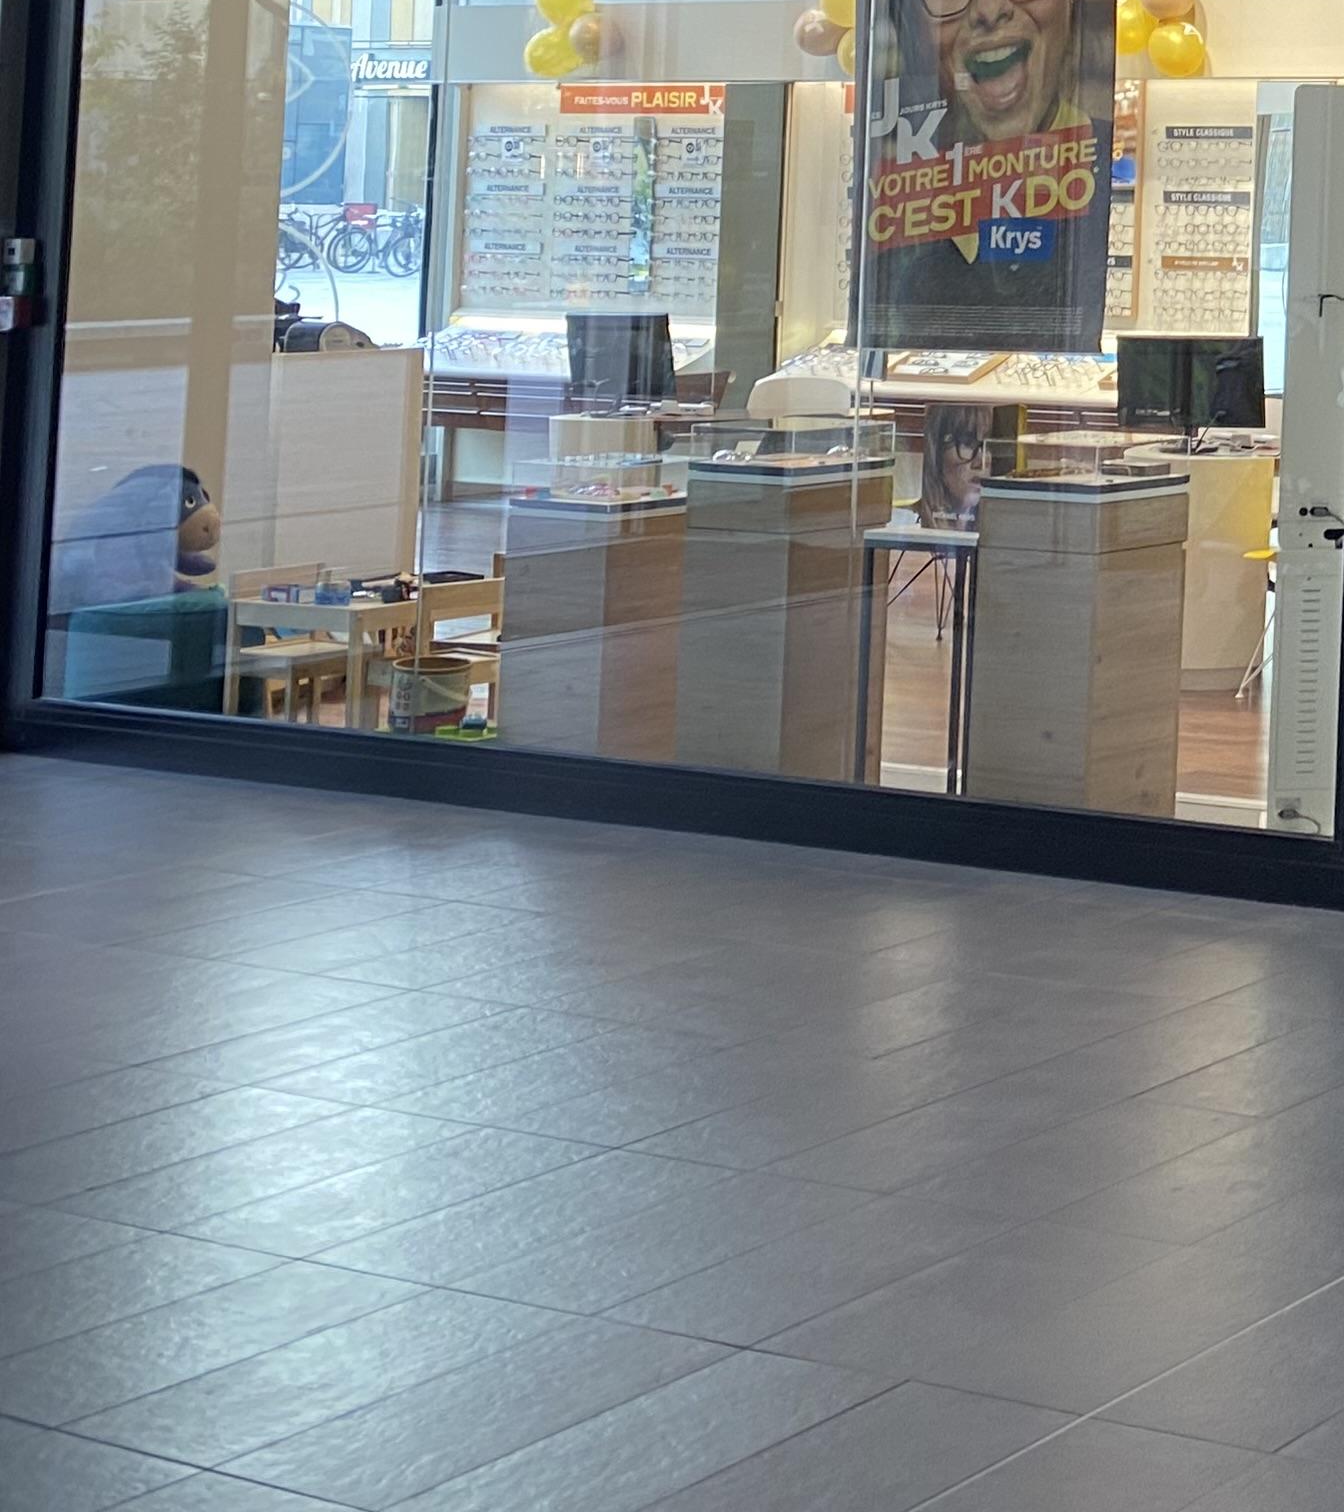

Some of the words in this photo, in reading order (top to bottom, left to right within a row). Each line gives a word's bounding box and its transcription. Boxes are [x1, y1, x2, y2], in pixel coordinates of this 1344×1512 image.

[350, 53, 428, 82] Avenue
[630, 90, 697, 108] PLAISIR
[490, 125, 531, 134] ALTERNANCE
[580, 126, 622, 134] ALTERNANCE
[671, 127, 716, 136] ALTERNANCE
[868, 164, 950, 199] VOTRE
[967, 138, 1098, 182] MONTURE
[487, 184, 529, 193] ALTERNANCE
[577, 186, 619, 194] ALTERNANCE
[669, 187, 714, 196] ALTERNANCE
[868, 188, 981, 242] C'EST
[990, 225, 1042, 254] Krys
[484, 242, 527, 252] ALTERNANCE
[575, 244, 617, 254] ALTERNANCE
[666, 247, 711, 257] ALTERNANCE
